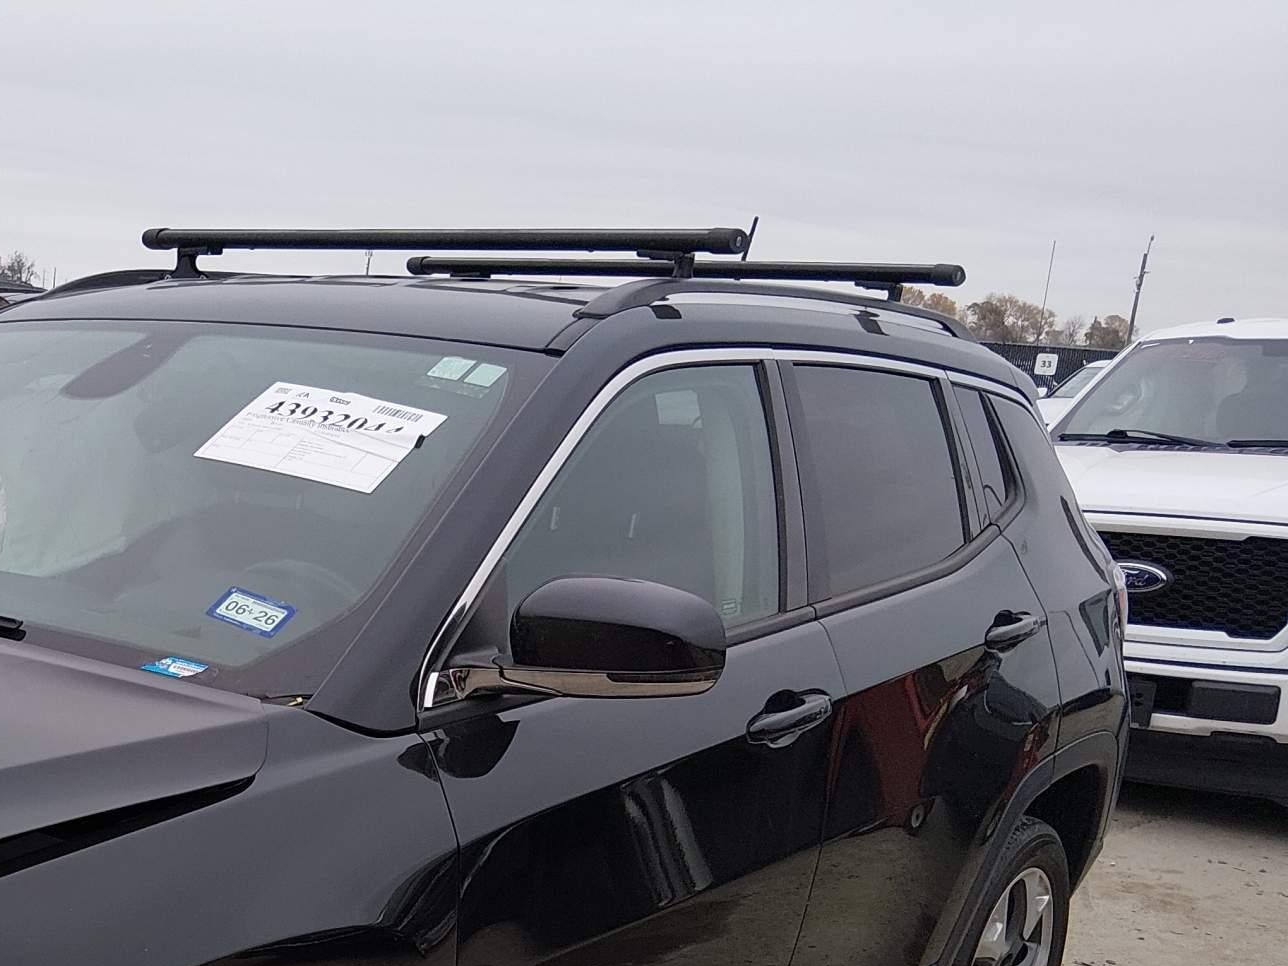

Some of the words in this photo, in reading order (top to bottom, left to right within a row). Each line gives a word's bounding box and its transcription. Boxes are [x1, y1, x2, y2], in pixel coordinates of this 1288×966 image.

[1040, 360, 1052, 369] 33
[225, 600, 249, 615] 06
[253, 610, 279, 626] 26
